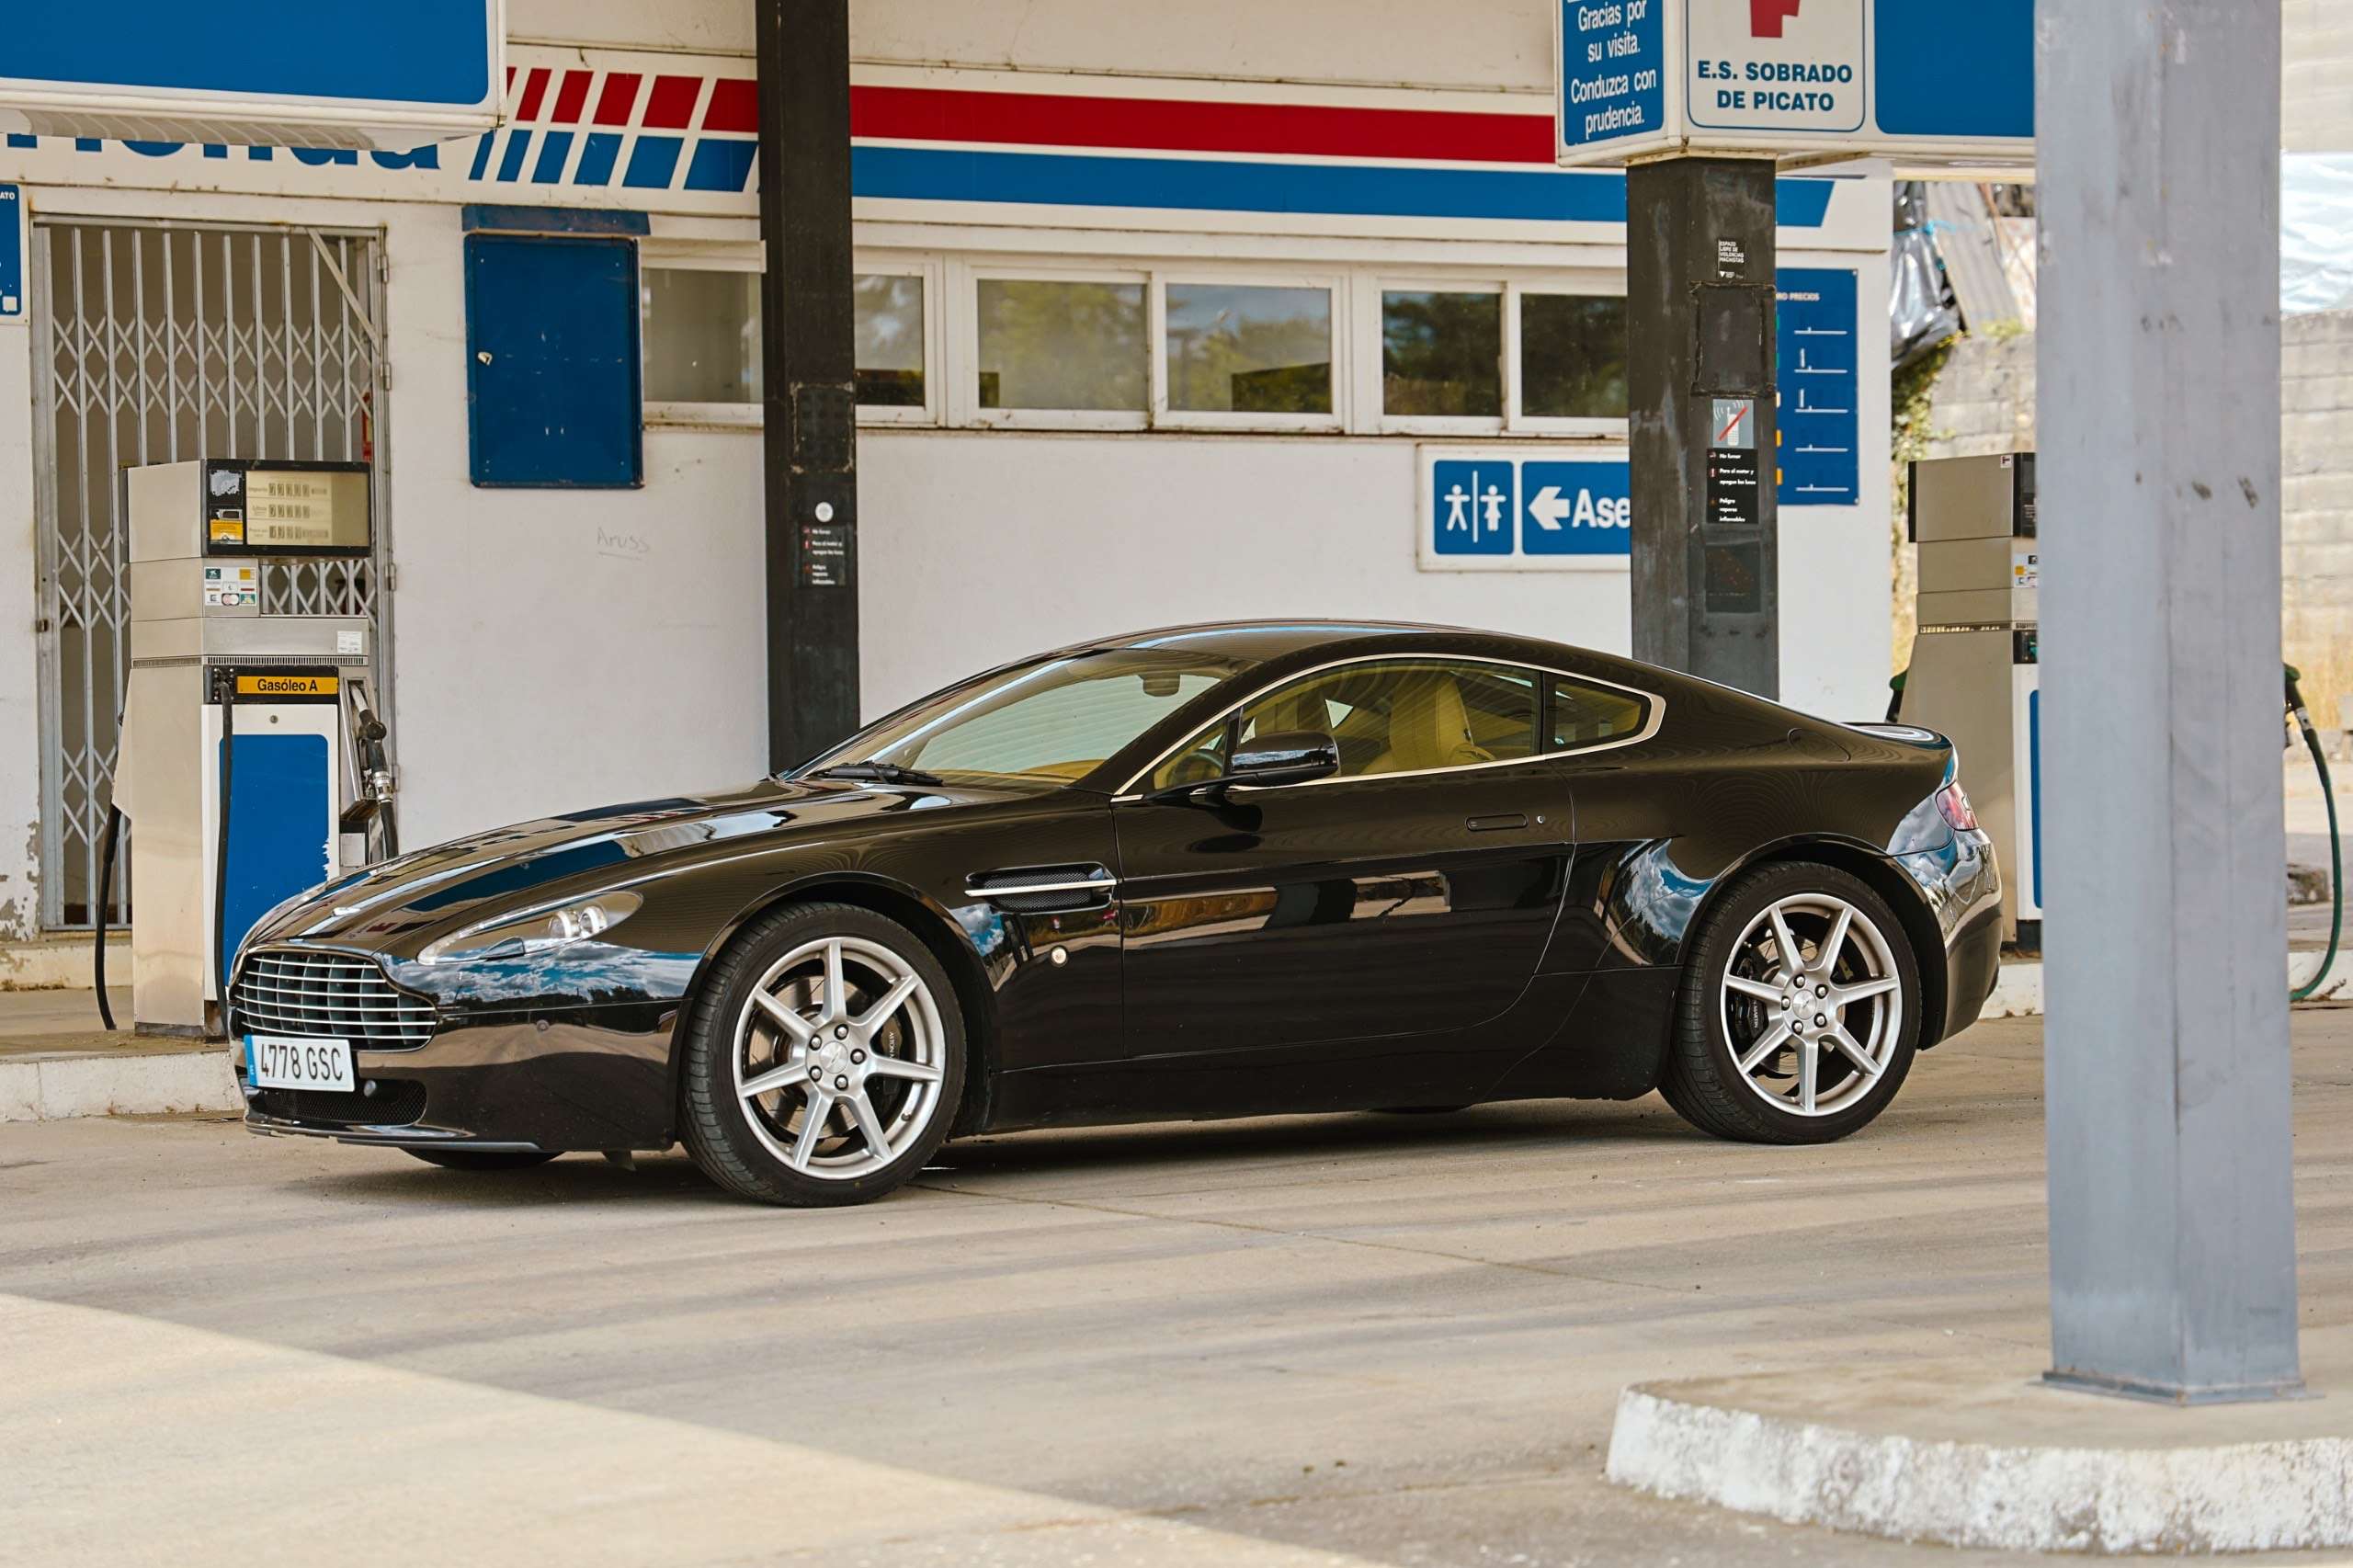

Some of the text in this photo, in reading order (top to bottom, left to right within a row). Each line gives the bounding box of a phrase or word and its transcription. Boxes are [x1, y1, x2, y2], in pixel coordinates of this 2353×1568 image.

[1578, 0, 1647, 31] Gracias por
[1587, 31, 1641, 62] su visita.
[1571, 68, 1657, 104] Conduzca con
[1698, 61, 1853, 84] E.S. SOBRADO
[1717, 90, 1835, 111] DE PICATO
[1586, 100, 1644, 140] prudencia.
[0, 191, 16, 200] ATO
[1572, 488, 1631, 528] Ase
[257, 678, 318, 692] Gasóleo A
[261, 1043, 343, 1081] 4778 GSC
